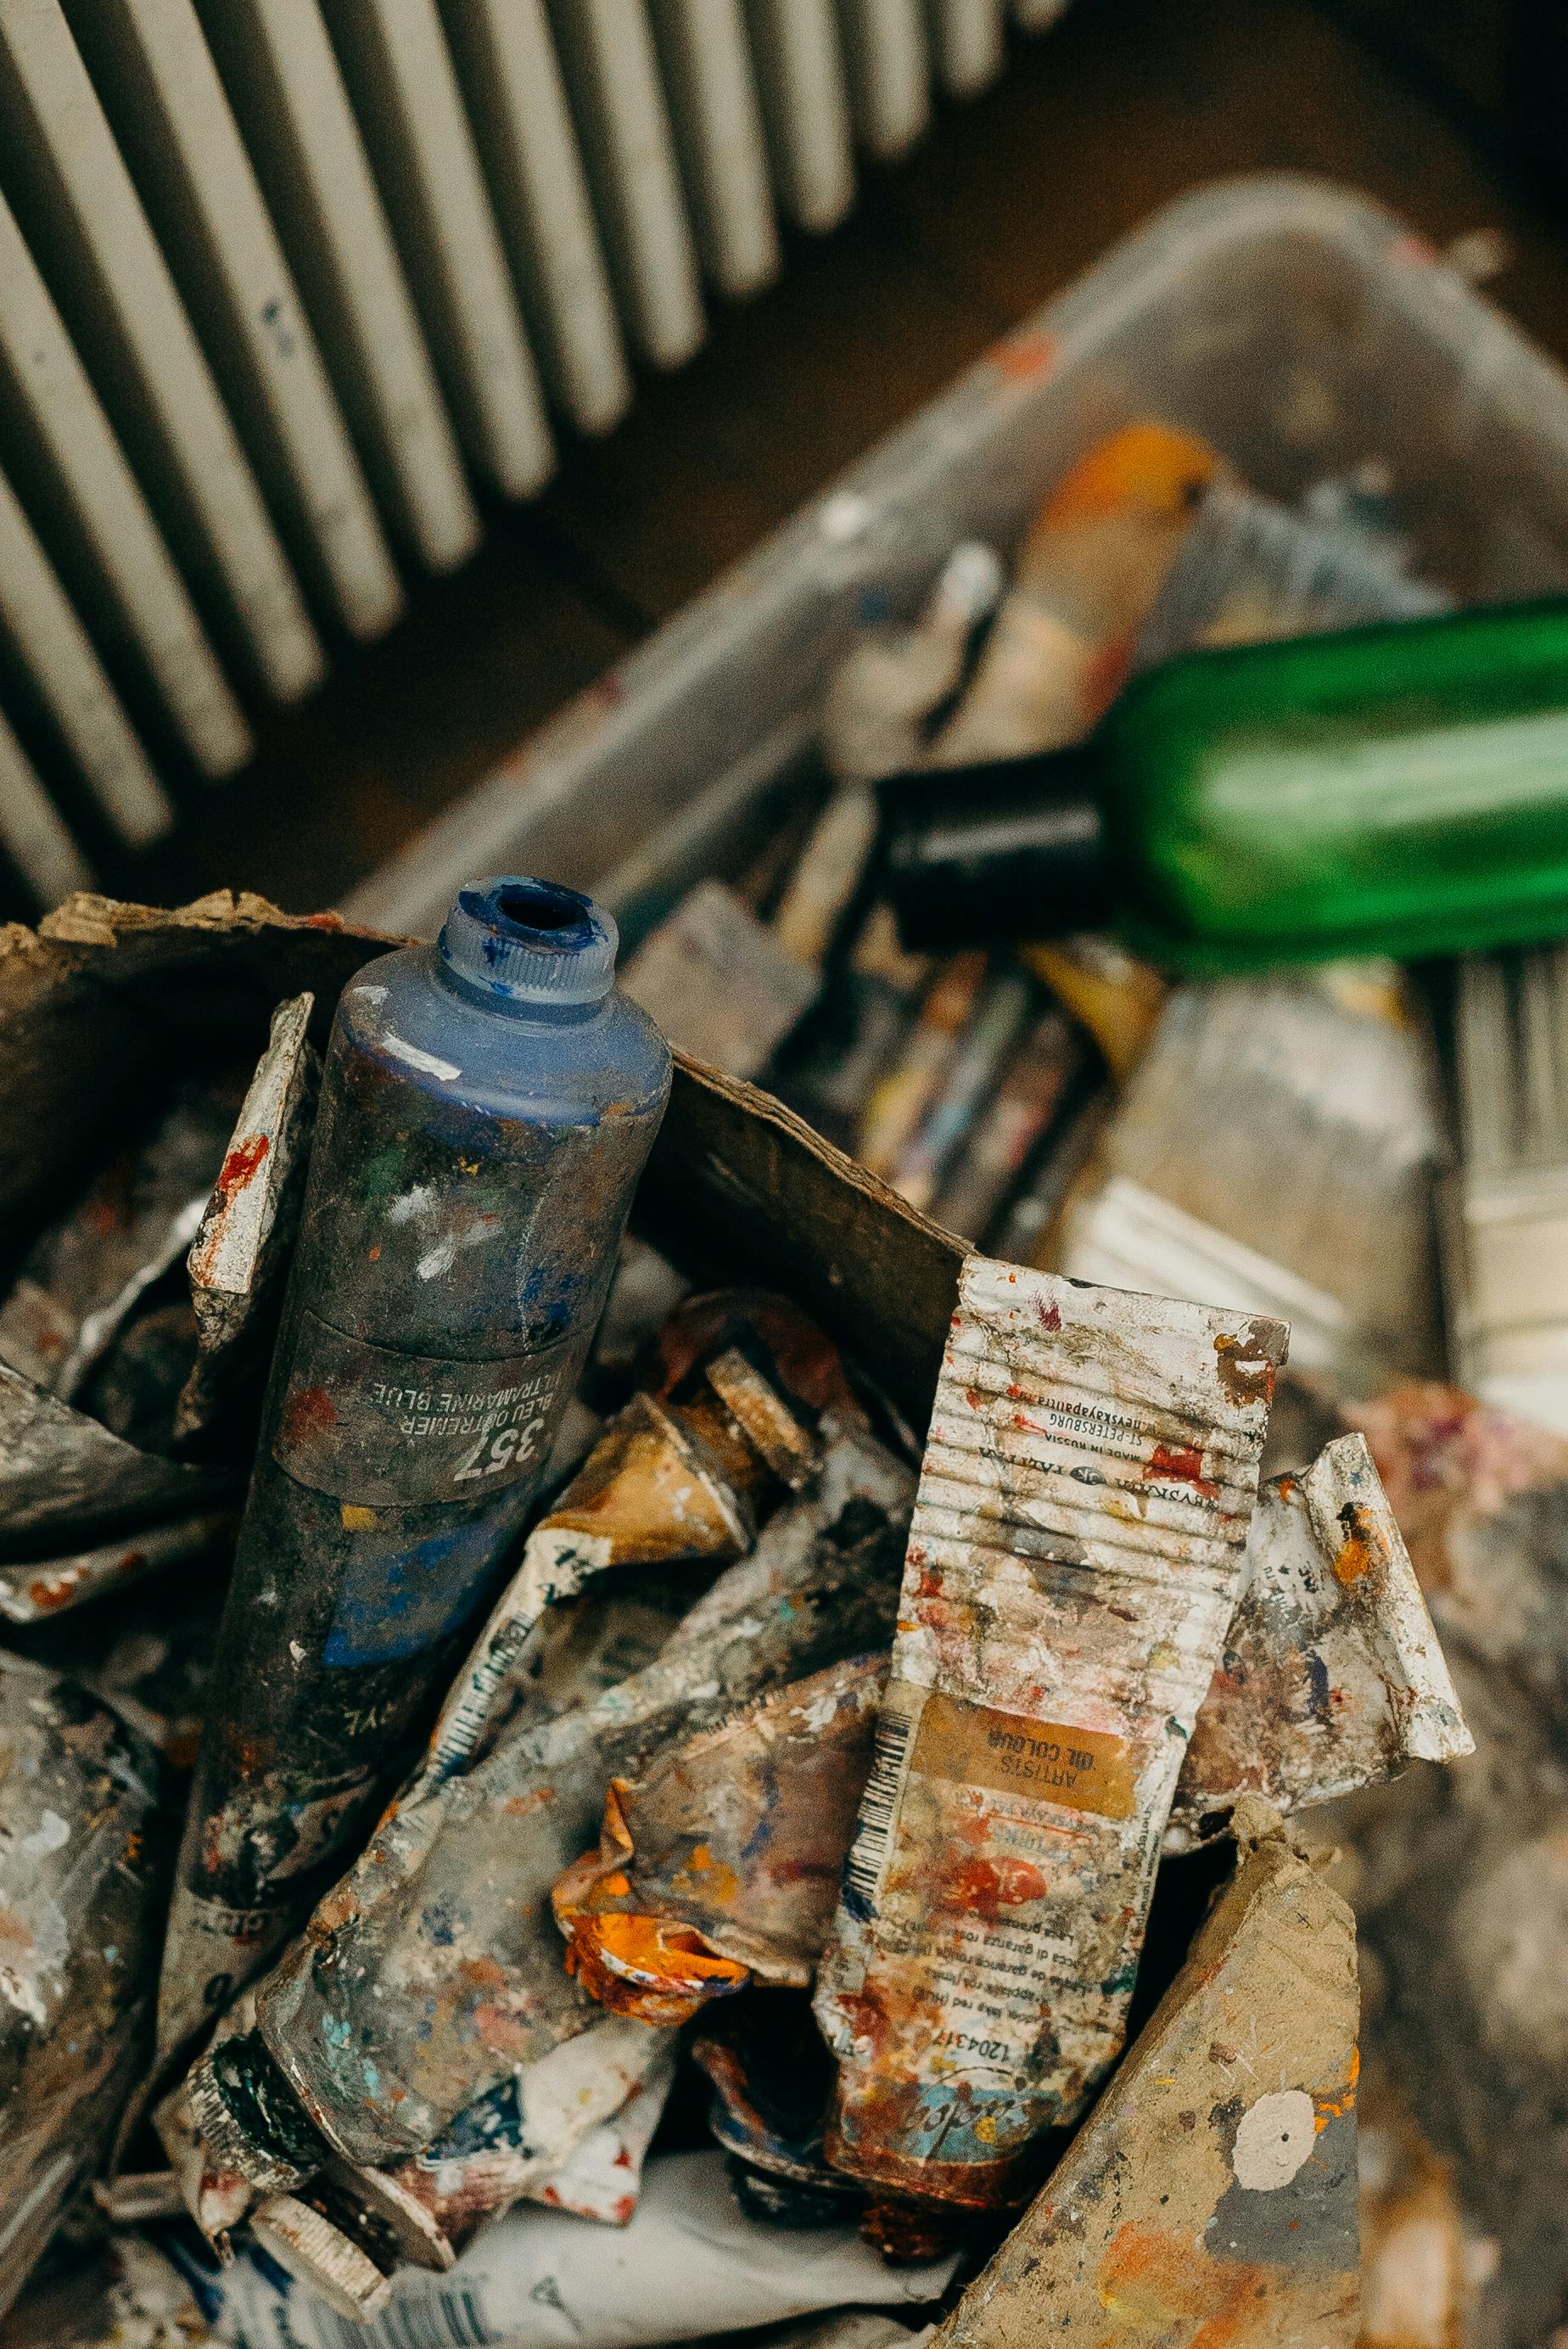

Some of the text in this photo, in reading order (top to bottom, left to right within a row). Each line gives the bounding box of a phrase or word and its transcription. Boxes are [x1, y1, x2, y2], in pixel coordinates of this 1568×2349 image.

[369, 1371, 561, 1412] ULTRAMARINE BLUE
[511, 1391, 552, 1422] BLEU
[1048, 1413, 1142, 1446] ST-PETERSBURG
[452, 1416, 544, 1482] 357
[1044, 1432, 1140, 1461] MADE IN RUSSIA
[986, 1730, 1095, 1772] OIL COLOUR
[1029, 1968, 1045, 1982] de
[951, 1996, 973, 2010] red
[932, 2028, 1009, 2063] 1204317
